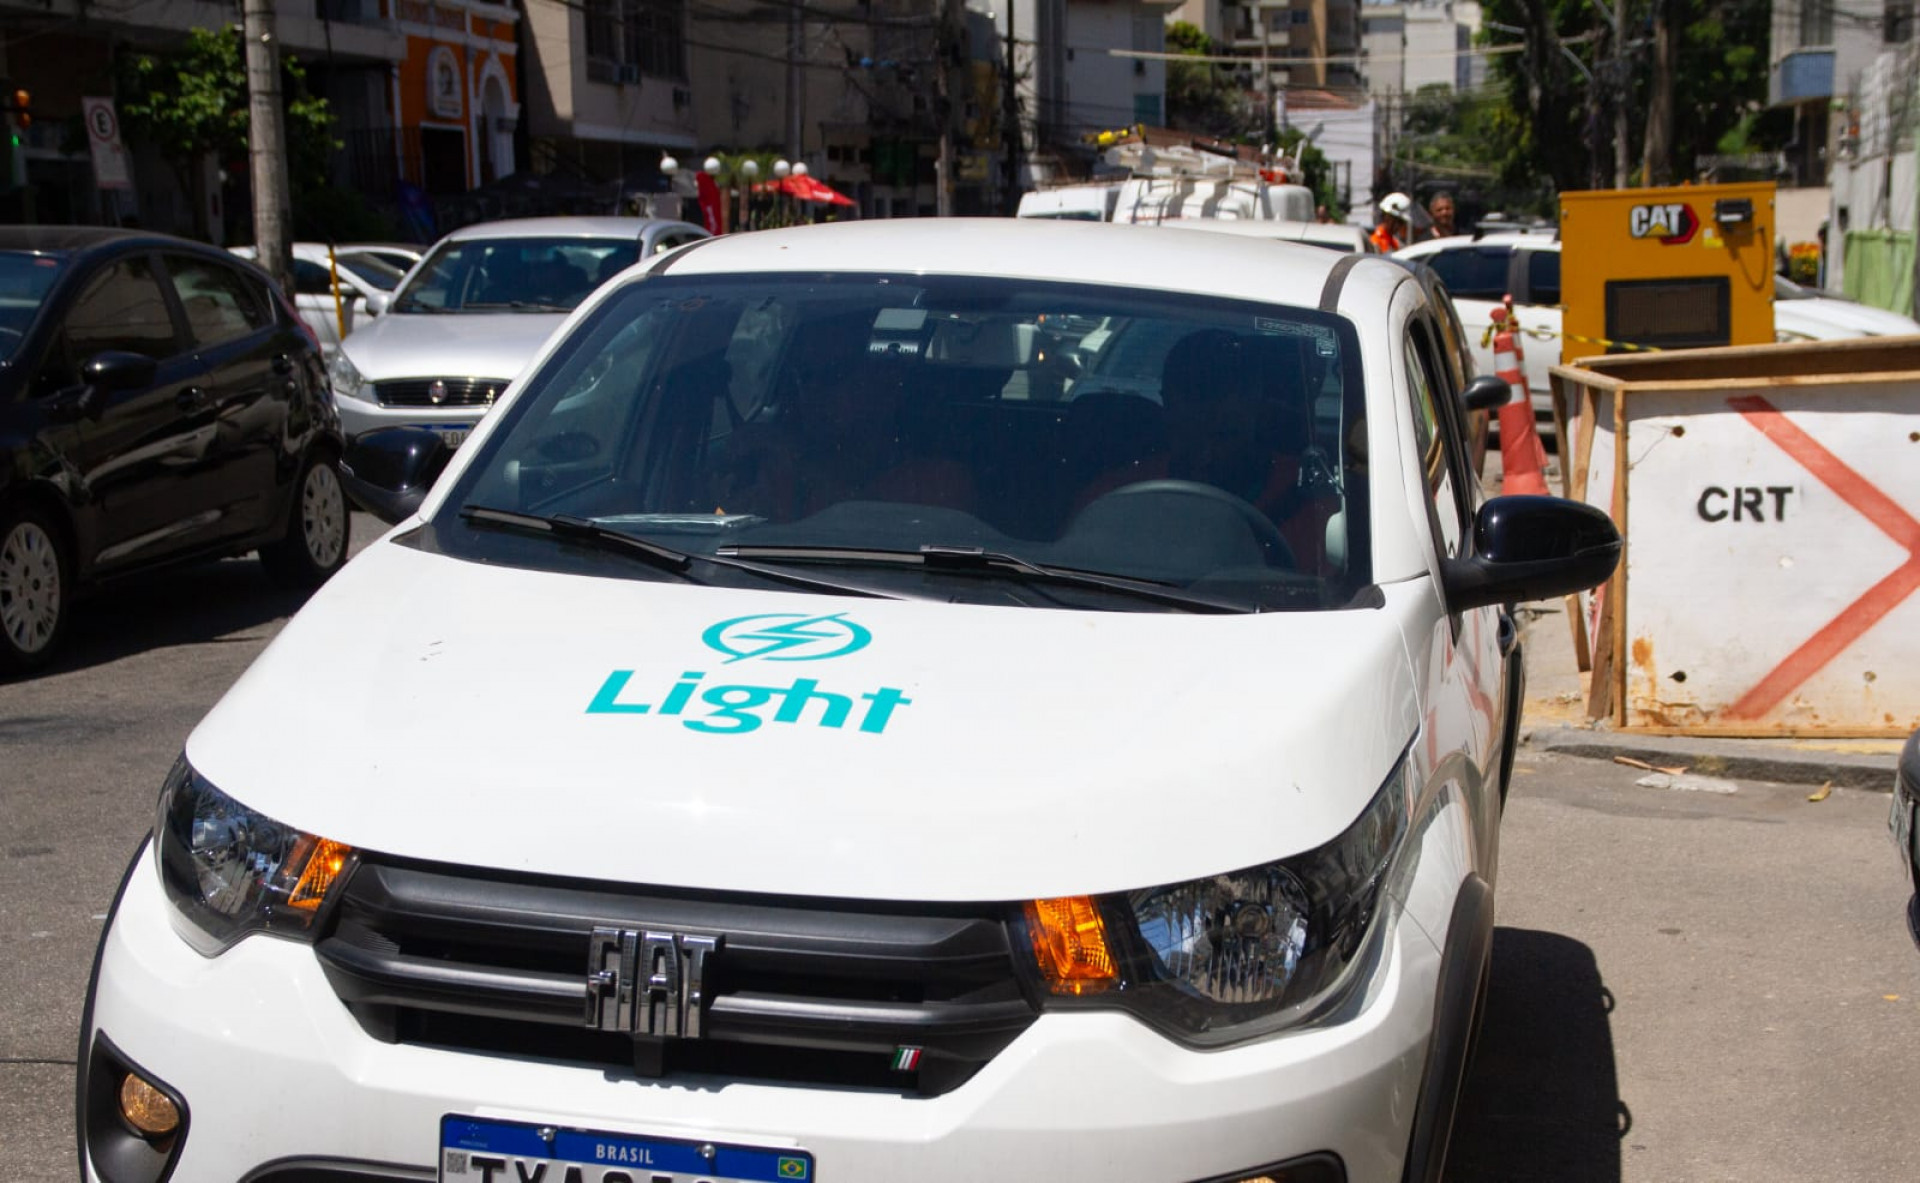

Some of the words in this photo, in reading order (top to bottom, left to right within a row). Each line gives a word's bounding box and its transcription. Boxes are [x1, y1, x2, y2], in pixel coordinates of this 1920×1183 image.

[96, 111, 108, 133] E
[1631, 204, 1683, 238] CAT
[1697, 486, 1794, 522] CRT
[585, 669, 912, 734] Light
[586, 926, 716, 1038] FIAT
[596, 1143, 654, 1165] BRASIL
